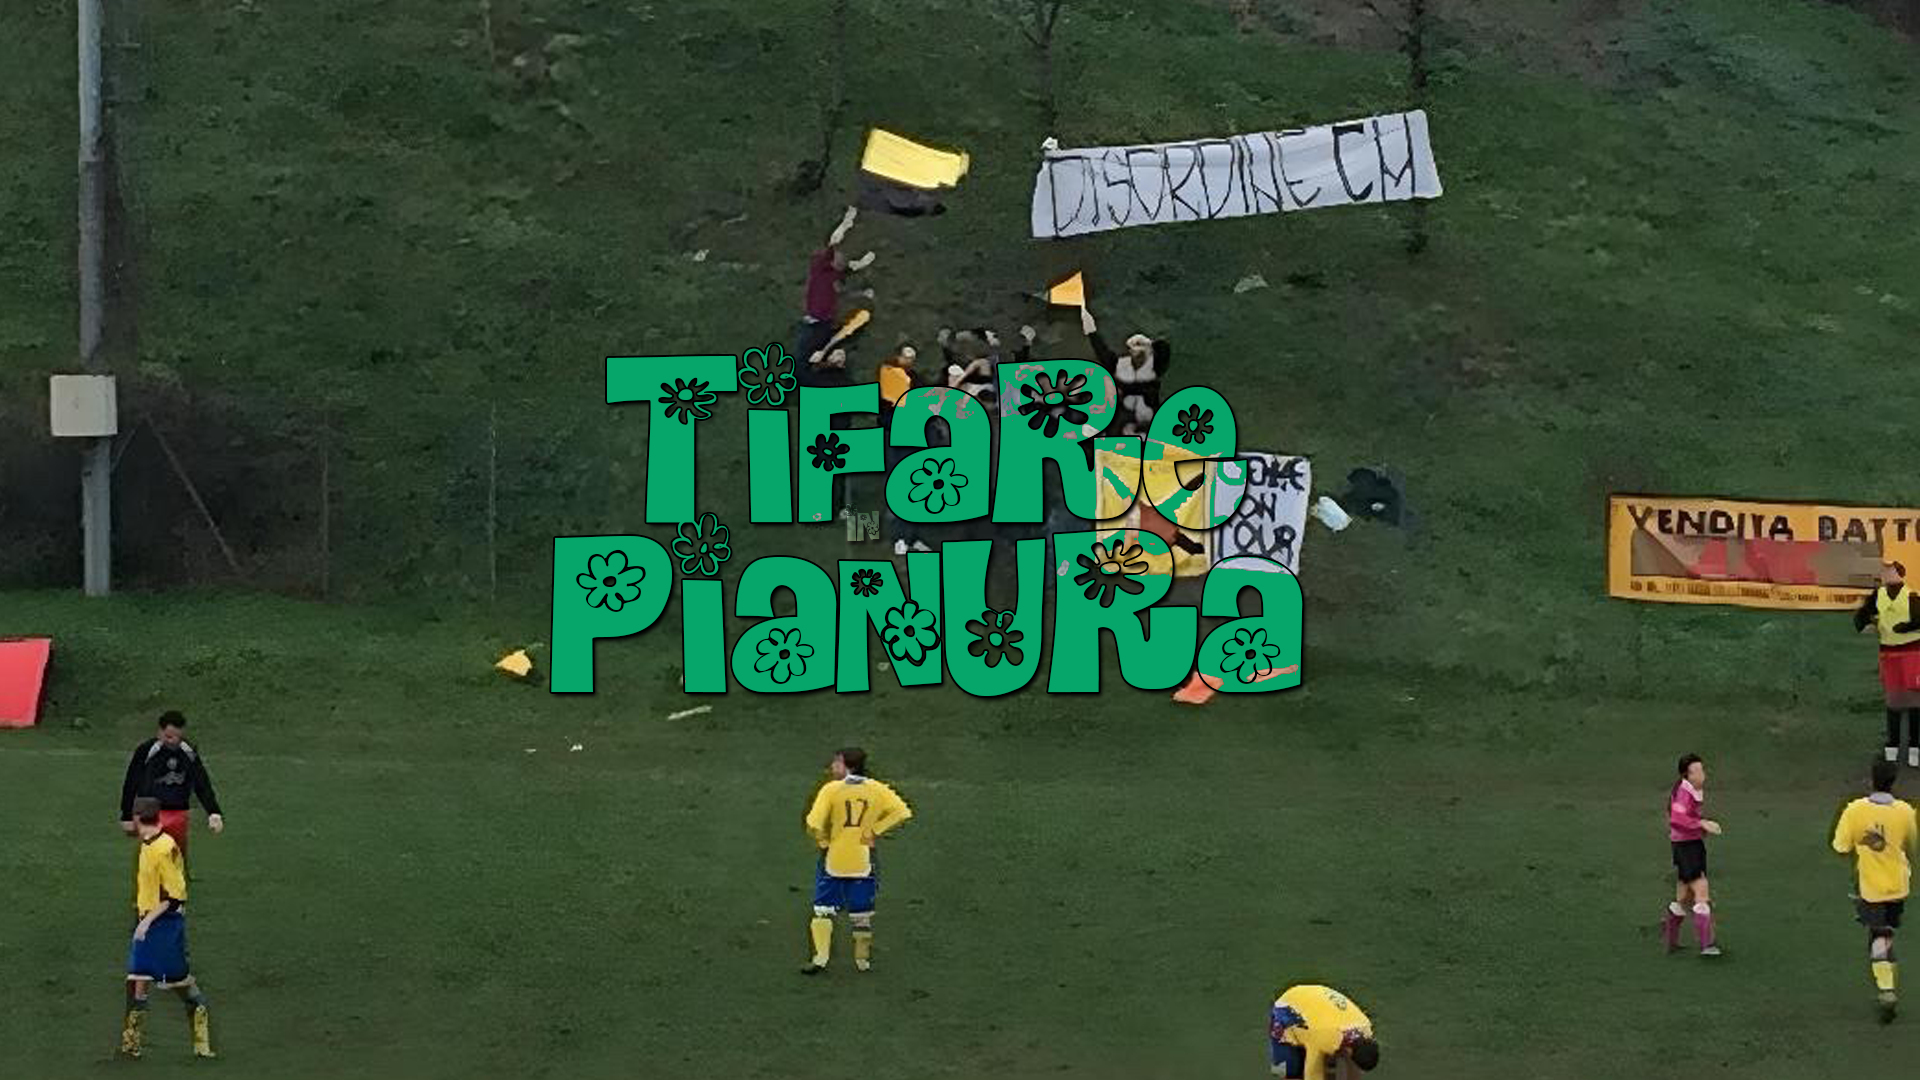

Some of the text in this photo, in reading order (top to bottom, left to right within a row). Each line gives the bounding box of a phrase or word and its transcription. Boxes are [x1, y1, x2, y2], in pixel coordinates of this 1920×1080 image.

[1049, 128, 1321, 238] DISORDINE
[1233, 493, 1277, 523] ON
[1627, 505, 1794, 542] VENDITA
[844, 798, 868, 827] 17
